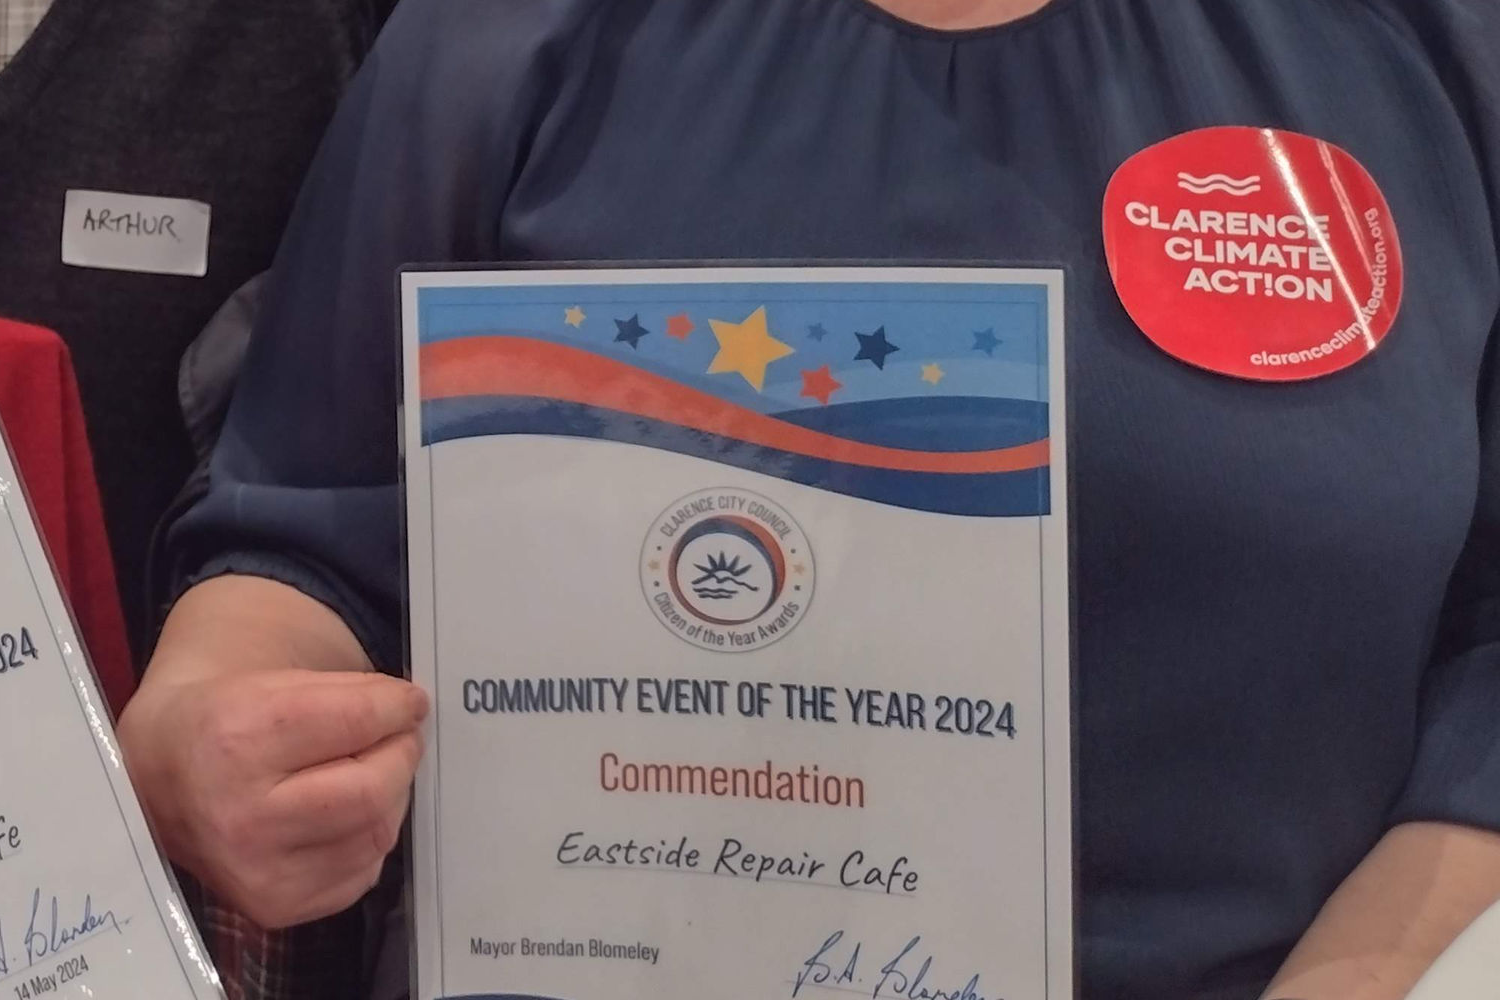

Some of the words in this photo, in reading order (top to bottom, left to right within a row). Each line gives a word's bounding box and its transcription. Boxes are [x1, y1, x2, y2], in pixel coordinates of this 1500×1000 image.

[83, 208, 181, 242] ARTHUR
[1124, 201, 1330, 241] CLARENCE
[1164, 236, 1332, 272] CLIMATE
[1183, 267, 1333, 303] ACT!ON
[660, 496, 715, 538] CLARENCE
[718, 495, 746, 510] CITY
[747, 500, 792, 540] COUNCIL
[654, 592, 687, 630] Citizen
[686, 624, 702, 639] of
[702, 630, 725, 646] the
[727, 631, 756, 646] Year
[759, 601, 799, 640] Awards
[462, 677, 629, 714] COMMUNITY
[636, 678, 729, 717] EVENT
[736, 681, 773, 718] OF
[780, 683, 838, 723] THE
[844, 687, 926, 730] YEAR
[935, 696, 1017, 739] 2024
[599, 752, 866, 809] Commendation
[556, 831, 700, 870] Eastside
[713, 838, 826, 883] Repair
[839, 850, 919, 894] Cafe
[470, 937, 516, 959] Mayor
[521, 937, 584, 957] Brendan
[589, 939, 660, 965] Blomeley
[14, 983, 31, 1000] 14
[30, 974, 58, 996] May
[57, 954, 89, 984] 2024
